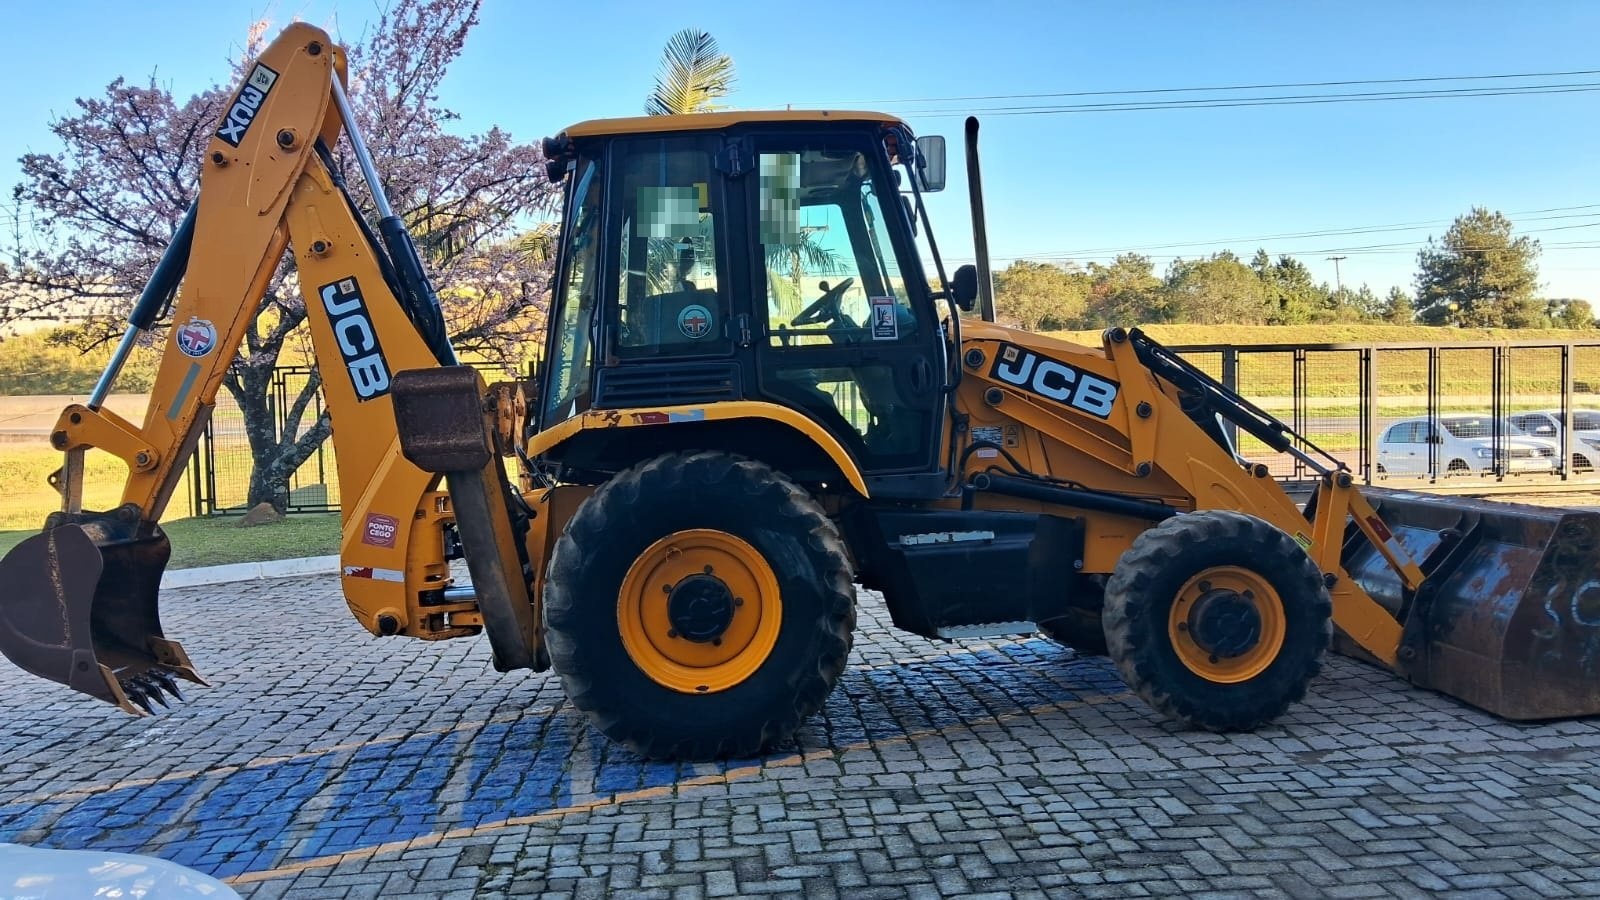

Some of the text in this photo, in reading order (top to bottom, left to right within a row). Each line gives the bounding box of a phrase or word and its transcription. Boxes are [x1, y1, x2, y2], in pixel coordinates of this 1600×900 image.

[218, 87, 263, 143] 3CX
[322, 285, 389, 397] JCB
[998, 353, 1117, 416] JCB
[368, 522, 395, 532] PONTO
[369, 529, 392, 538] CEGO
